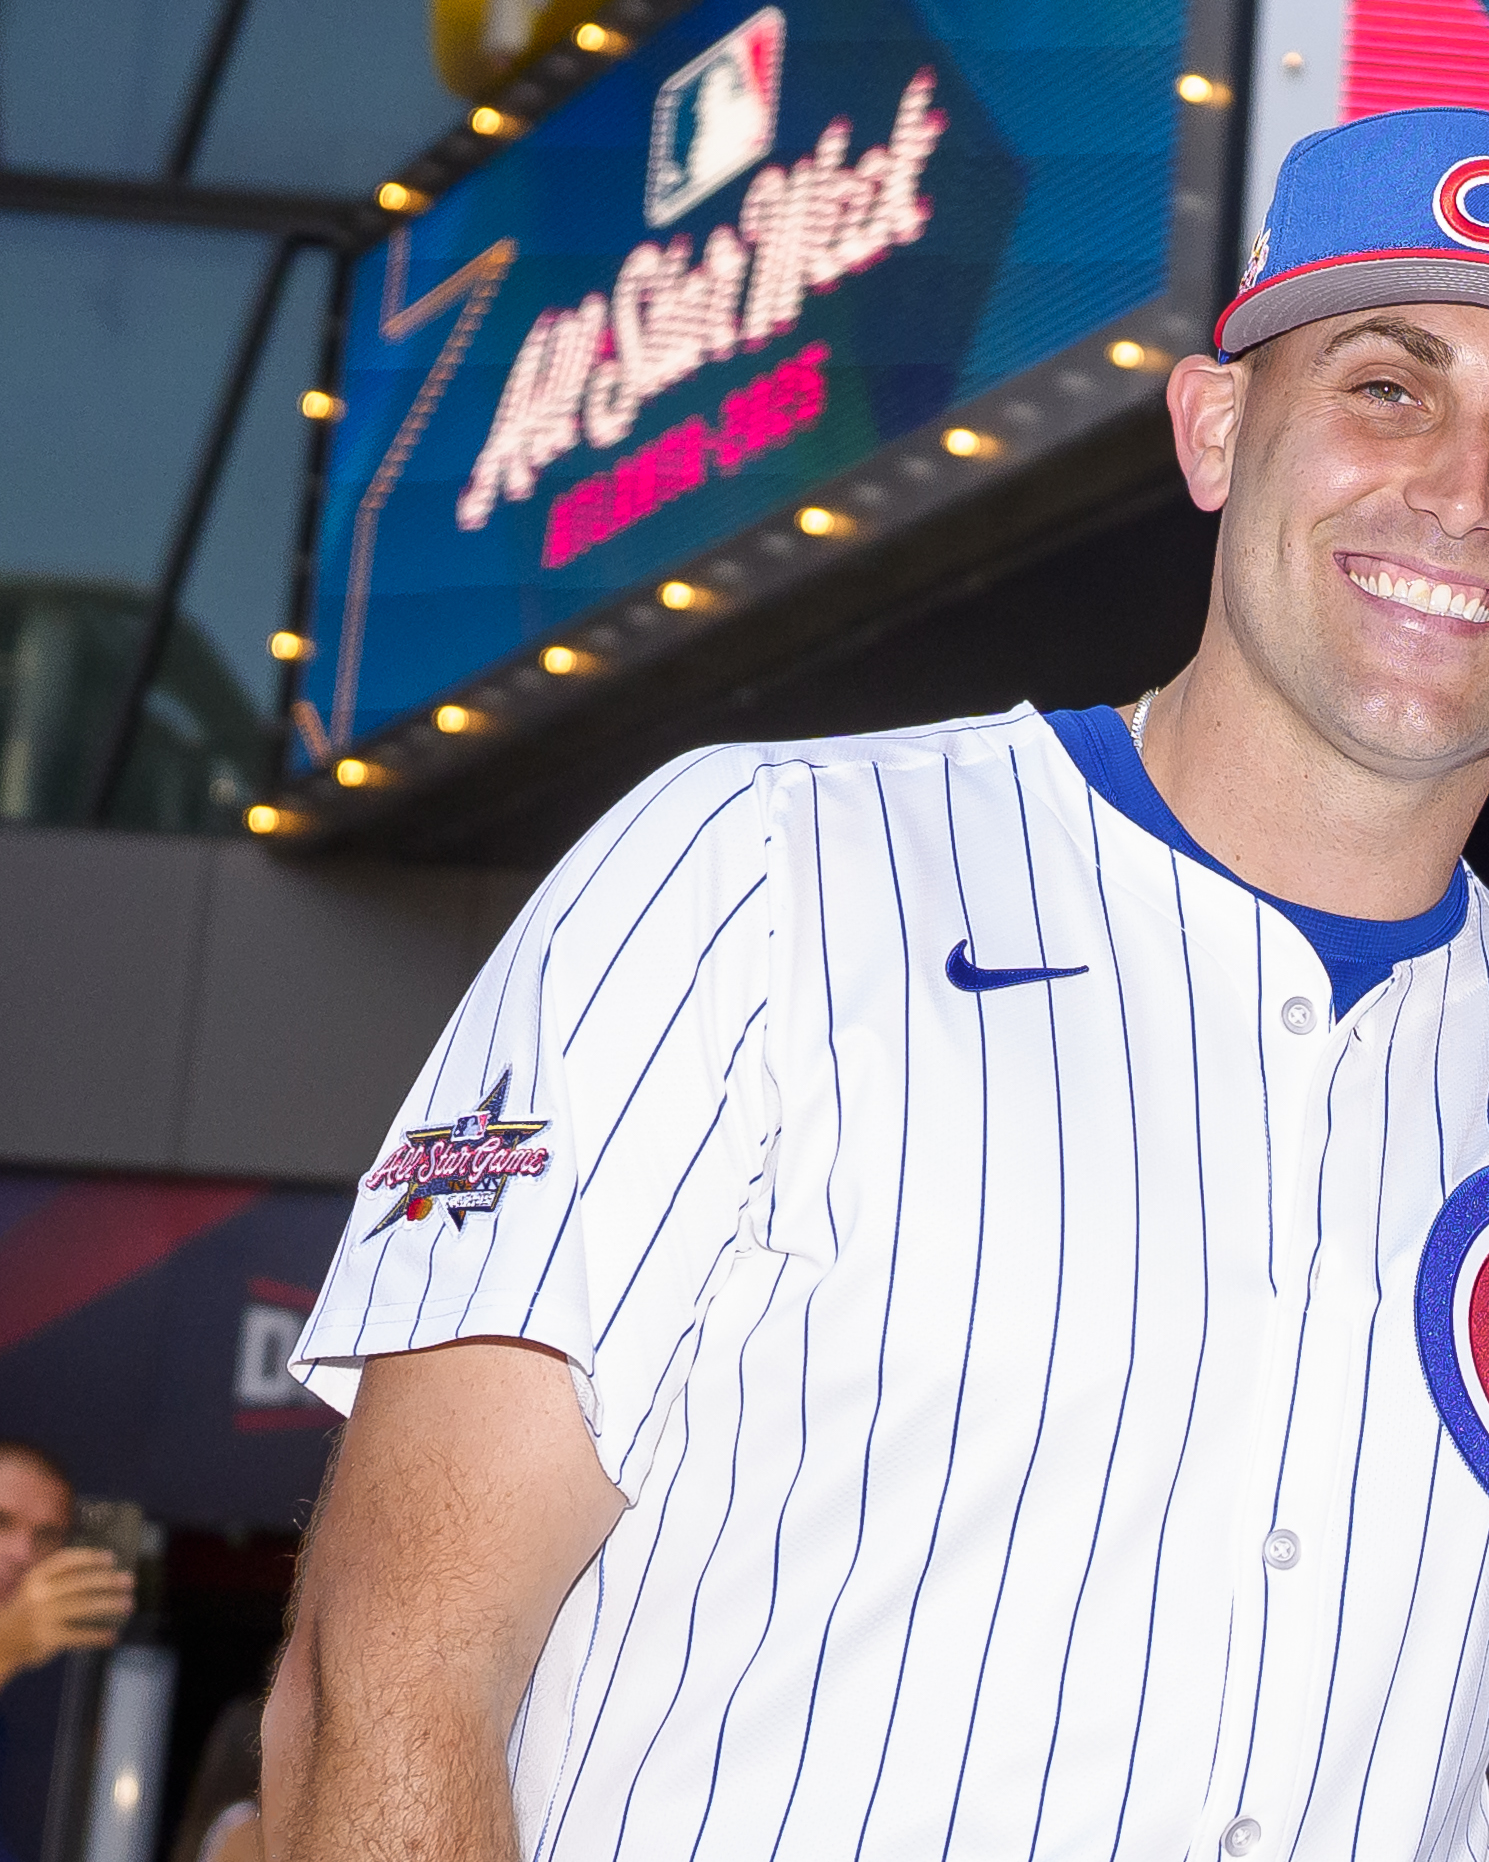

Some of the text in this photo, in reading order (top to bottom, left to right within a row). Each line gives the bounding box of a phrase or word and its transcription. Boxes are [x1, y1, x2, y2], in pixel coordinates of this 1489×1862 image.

[366, 1136, 549, 1190] All Star Game
